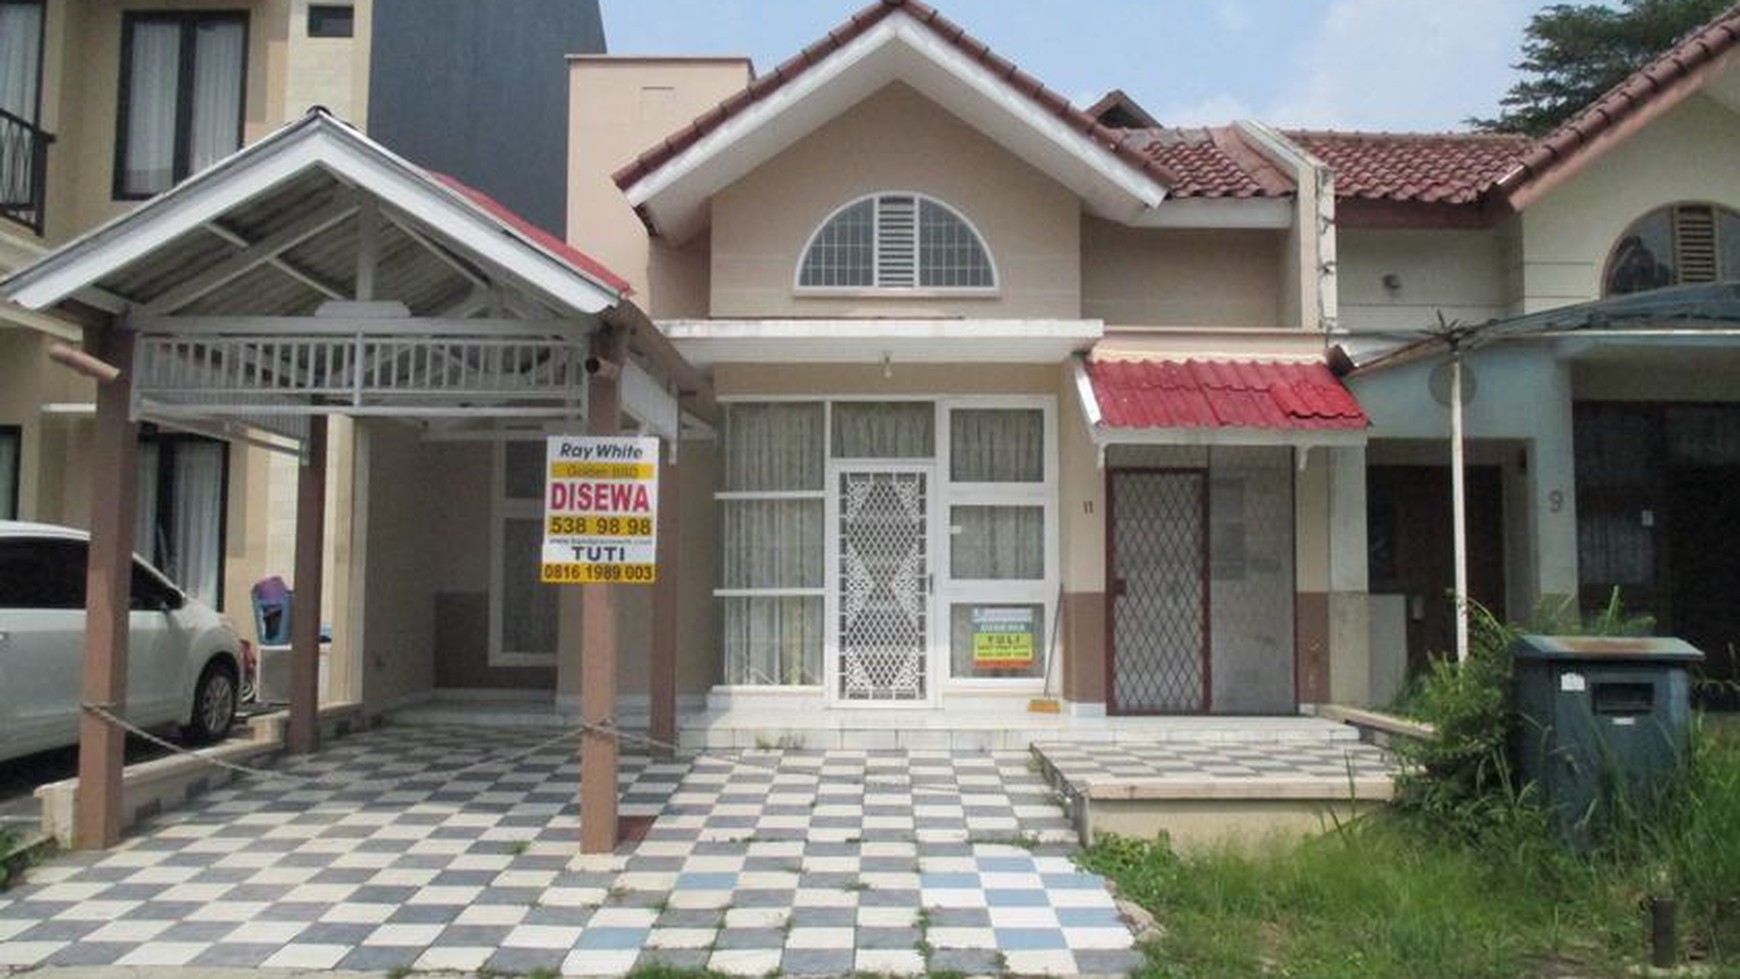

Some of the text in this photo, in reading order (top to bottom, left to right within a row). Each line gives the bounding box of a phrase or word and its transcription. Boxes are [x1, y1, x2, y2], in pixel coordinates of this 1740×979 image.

[561, 442, 643, 460] Ray White
[551, 482, 649, 511] DISEWA
[1548, 490, 1563, 513] 9
[1083, 500, 1093, 514] 11
[551, 516, 651, 535] 538 98 98
[571, 546, 625, 561] TUTI
[544, 564, 652, 580] 0816 1989 003
